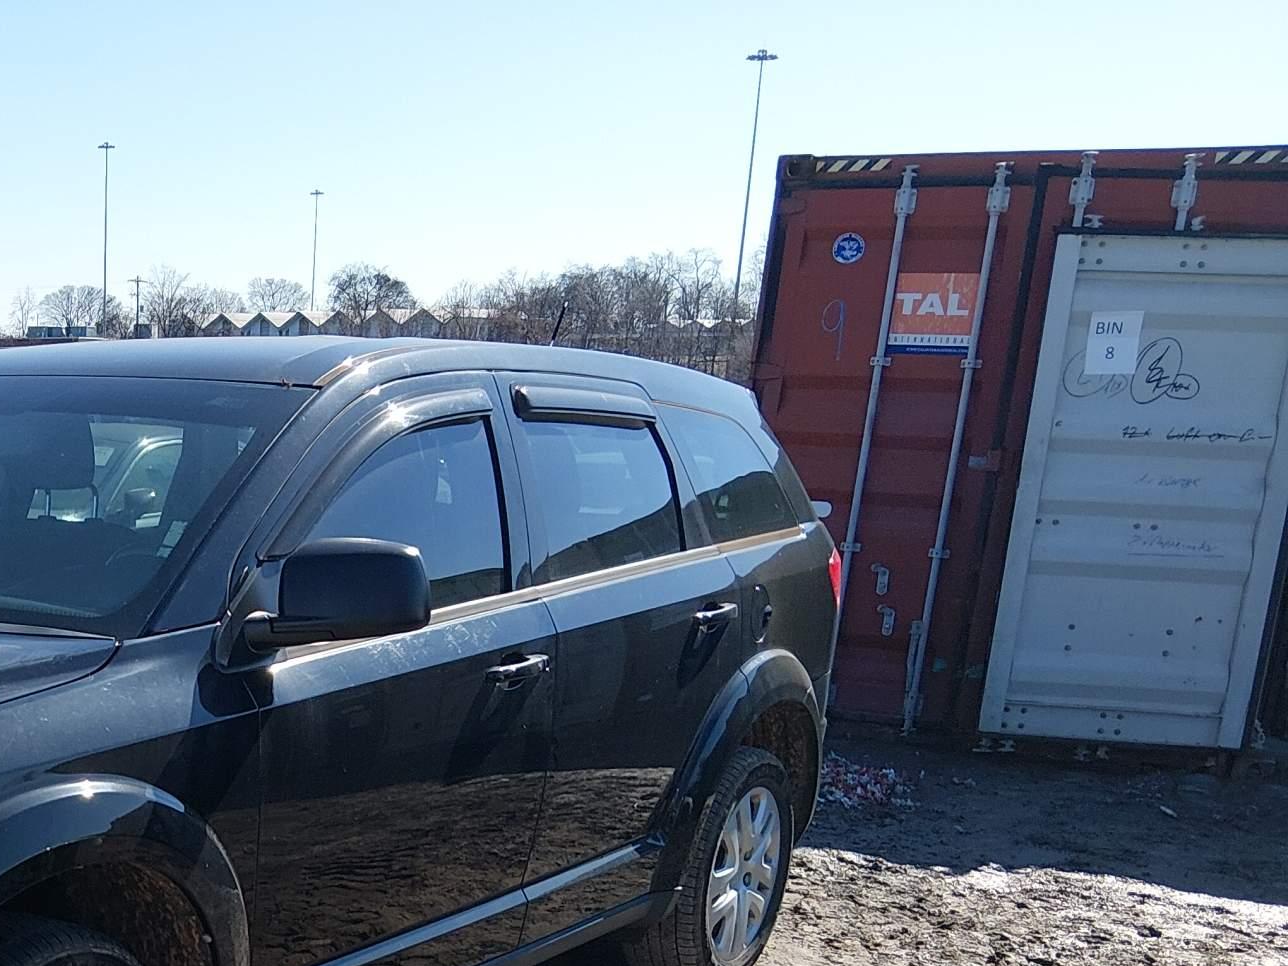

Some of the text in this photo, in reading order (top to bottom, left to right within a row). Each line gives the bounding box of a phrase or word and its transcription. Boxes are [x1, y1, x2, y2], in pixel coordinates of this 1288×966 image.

[896, 293, 969, 316] TAL
[1095, 321, 1124, 335] BIN
[1104, 346, 1115, 359] 8
